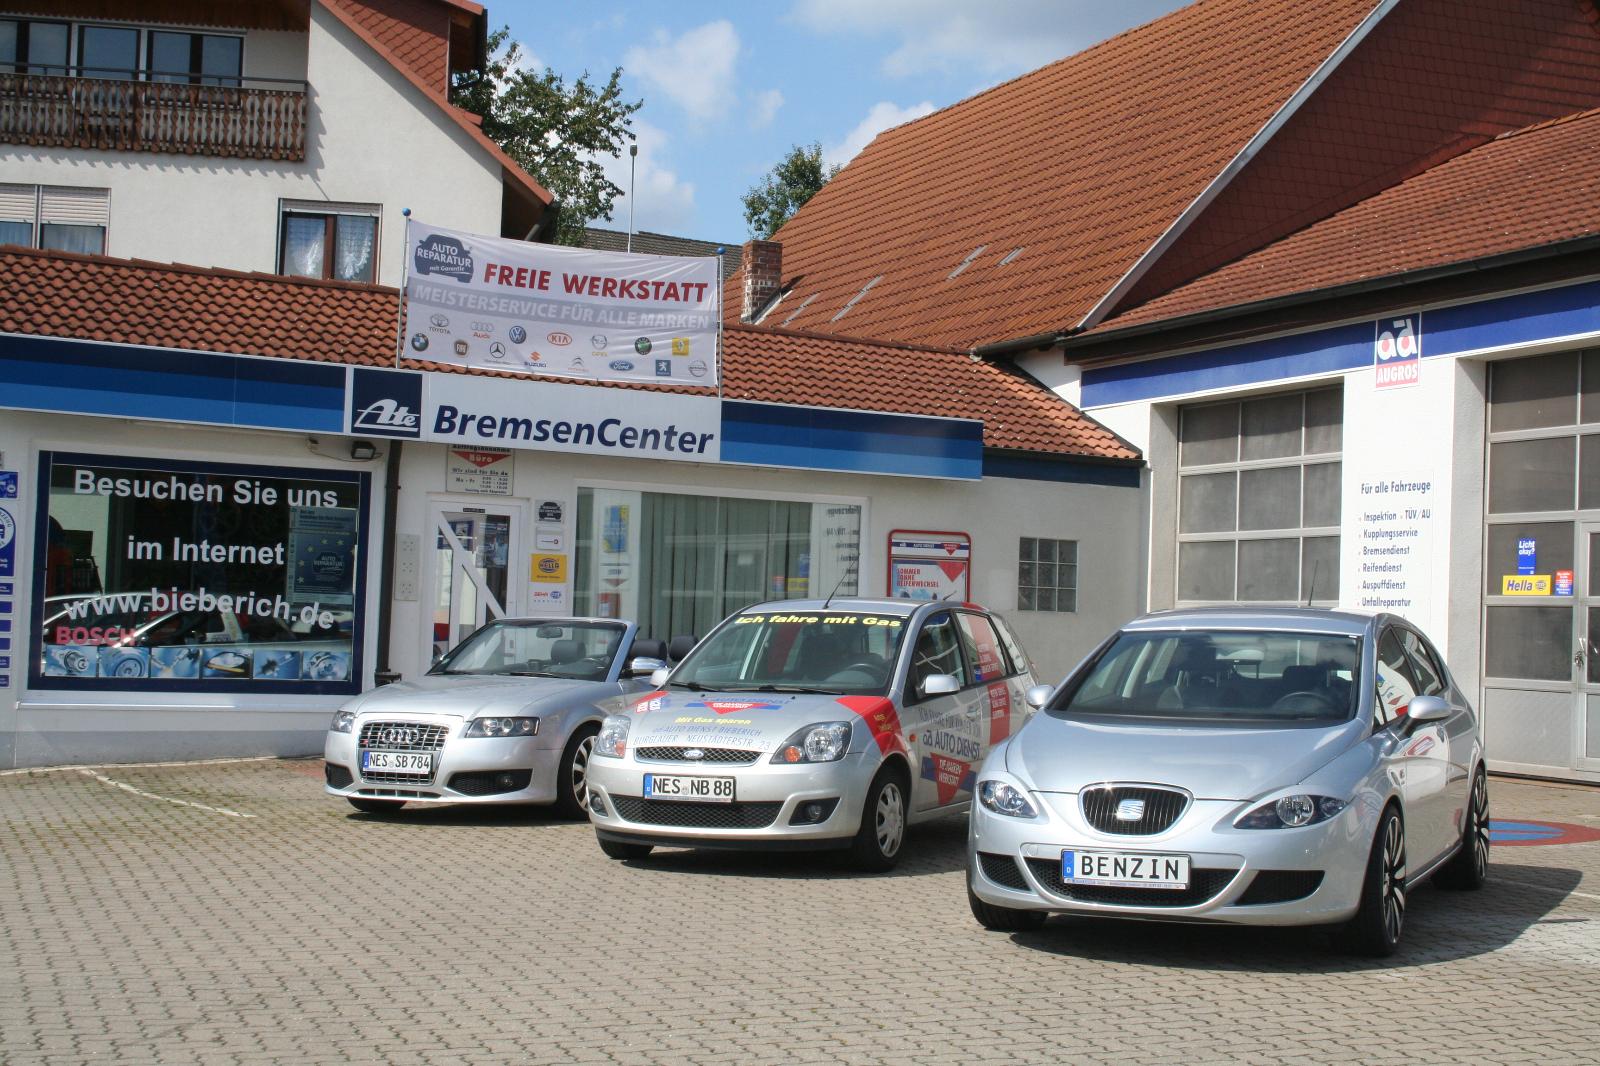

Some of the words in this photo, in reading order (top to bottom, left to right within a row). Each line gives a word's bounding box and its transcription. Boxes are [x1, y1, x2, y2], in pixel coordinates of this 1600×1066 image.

[431, 242, 459, 256] AUTO
[417, 247, 472, 268] REPARATUR
[484, 263, 552, 291] FREIE
[563, 273, 708, 302] WERKSTATT
[415, 286, 557, 318] MEISTERSERVICE
[560, 302, 593, 322] FÜR
[597, 309, 637, 326] ALLE
[640, 312, 709, 329] MARKEN
[429, 326, 451, 335] TOYOTA
[551, 335, 569, 343] KIA
[1377, 364, 1417, 384] AUGROS
[354, 398, 420, 430] Ate
[433, 404, 714, 454] BremsenCenter
[75, 469, 223, 503] Besuchen
[233, 480, 277, 505] Sie
[288, 486, 338, 508] uns
[1361, 483, 1372, 494] Für
[1375, 481, 1388, 493] alle
[1391, 480, 1431, 494] Fahrzeuge
[1364, 511, 1397, 523] Inspektion
[1363, 527, 1418, 540] Kupplungsservice
[128, 535, 162, 561] im
[173, 536, 284, 566] Internet
[1363, 545, 1410, 555] Bremsendienst
[1519, 540, 1535, 548] Licht
[1362, 562, 1402, 572] Reifendienst
[1362, 579, 1406, 591] Auspuffdienst
[1507, 579, 1533, 592] Hella
[64, 586, 335, 630] www.bieberich.de
[1362, 597, 1411, 608] Unfallreparatur
[735, 616, 764, 624] Ich
[769, 615, 818, 623] fahre
[824, 615, 857, 624] mit
[862, 617, 901, 627] Gas
[56, 626, 136, 646] BOSCH
[715, 717, 752, 725] sparen
[935, 730, 955, 753] AUTO
[956, 737, 981, 760] DIENST
[370, 754, 388, 767] NES
[395, 755, 408, 768] SB
[411, 756, 429, 768] 784
[653, 778, 680, 794] NES
[691, 779, 709, 795] NB
[713, 780, 732, 796] 88
[1081, 855, 1179, 880] BENZIN
